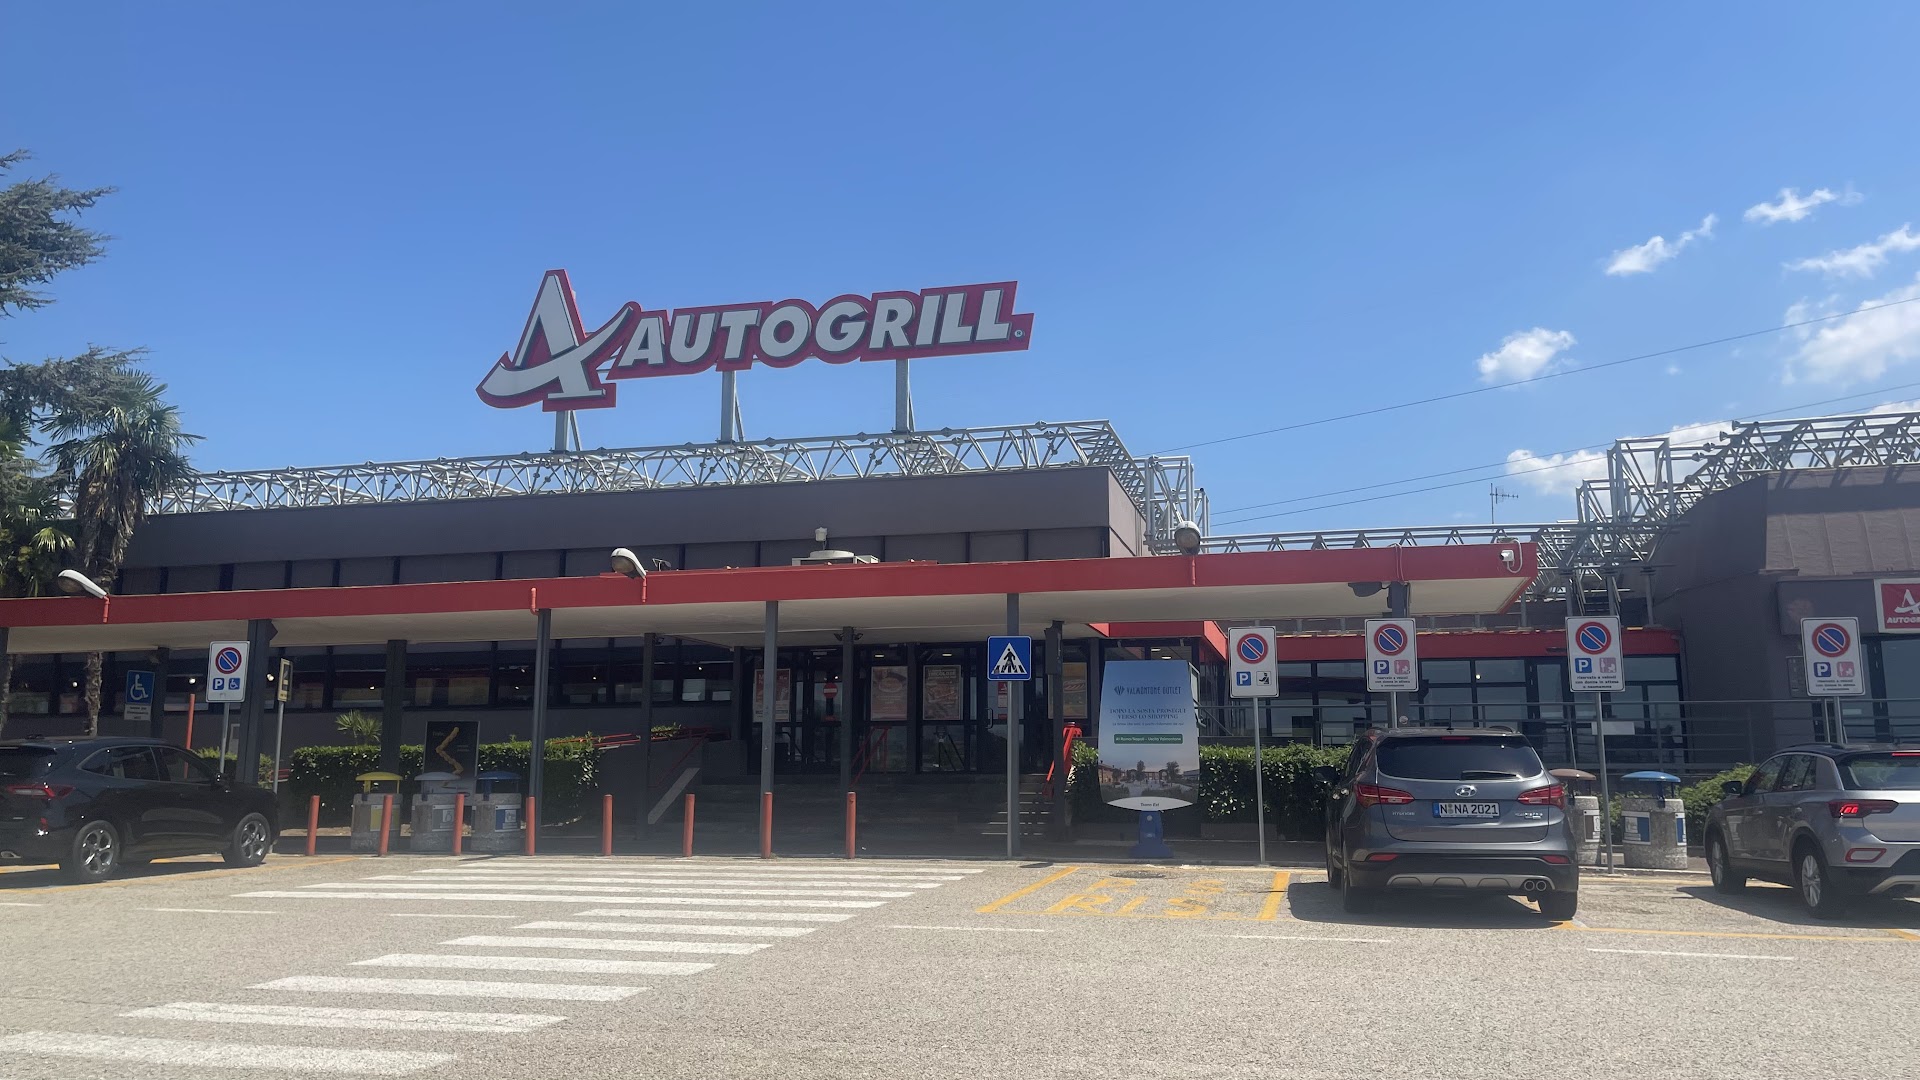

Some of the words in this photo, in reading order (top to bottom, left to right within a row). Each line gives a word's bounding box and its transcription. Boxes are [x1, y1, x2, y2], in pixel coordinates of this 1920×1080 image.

[618, 288, 1011, 368] AUTOGRILL
[1376, 661, 1387, 674] P
[1579, 660, 1589, 672] P
[1816, 664, 1828, 676] P
[214, 679, 223, 690] P
[1240, 673, 1249, 684] P
[1126, 686, 1161, 695] VALMONTONE
[1162, 686, 1182, 695] OUTLET
[1440, 803, 1448, 814] N
[1454, 803, 1469, 814] NA
[1470, 803, 1499, 815] 2021
